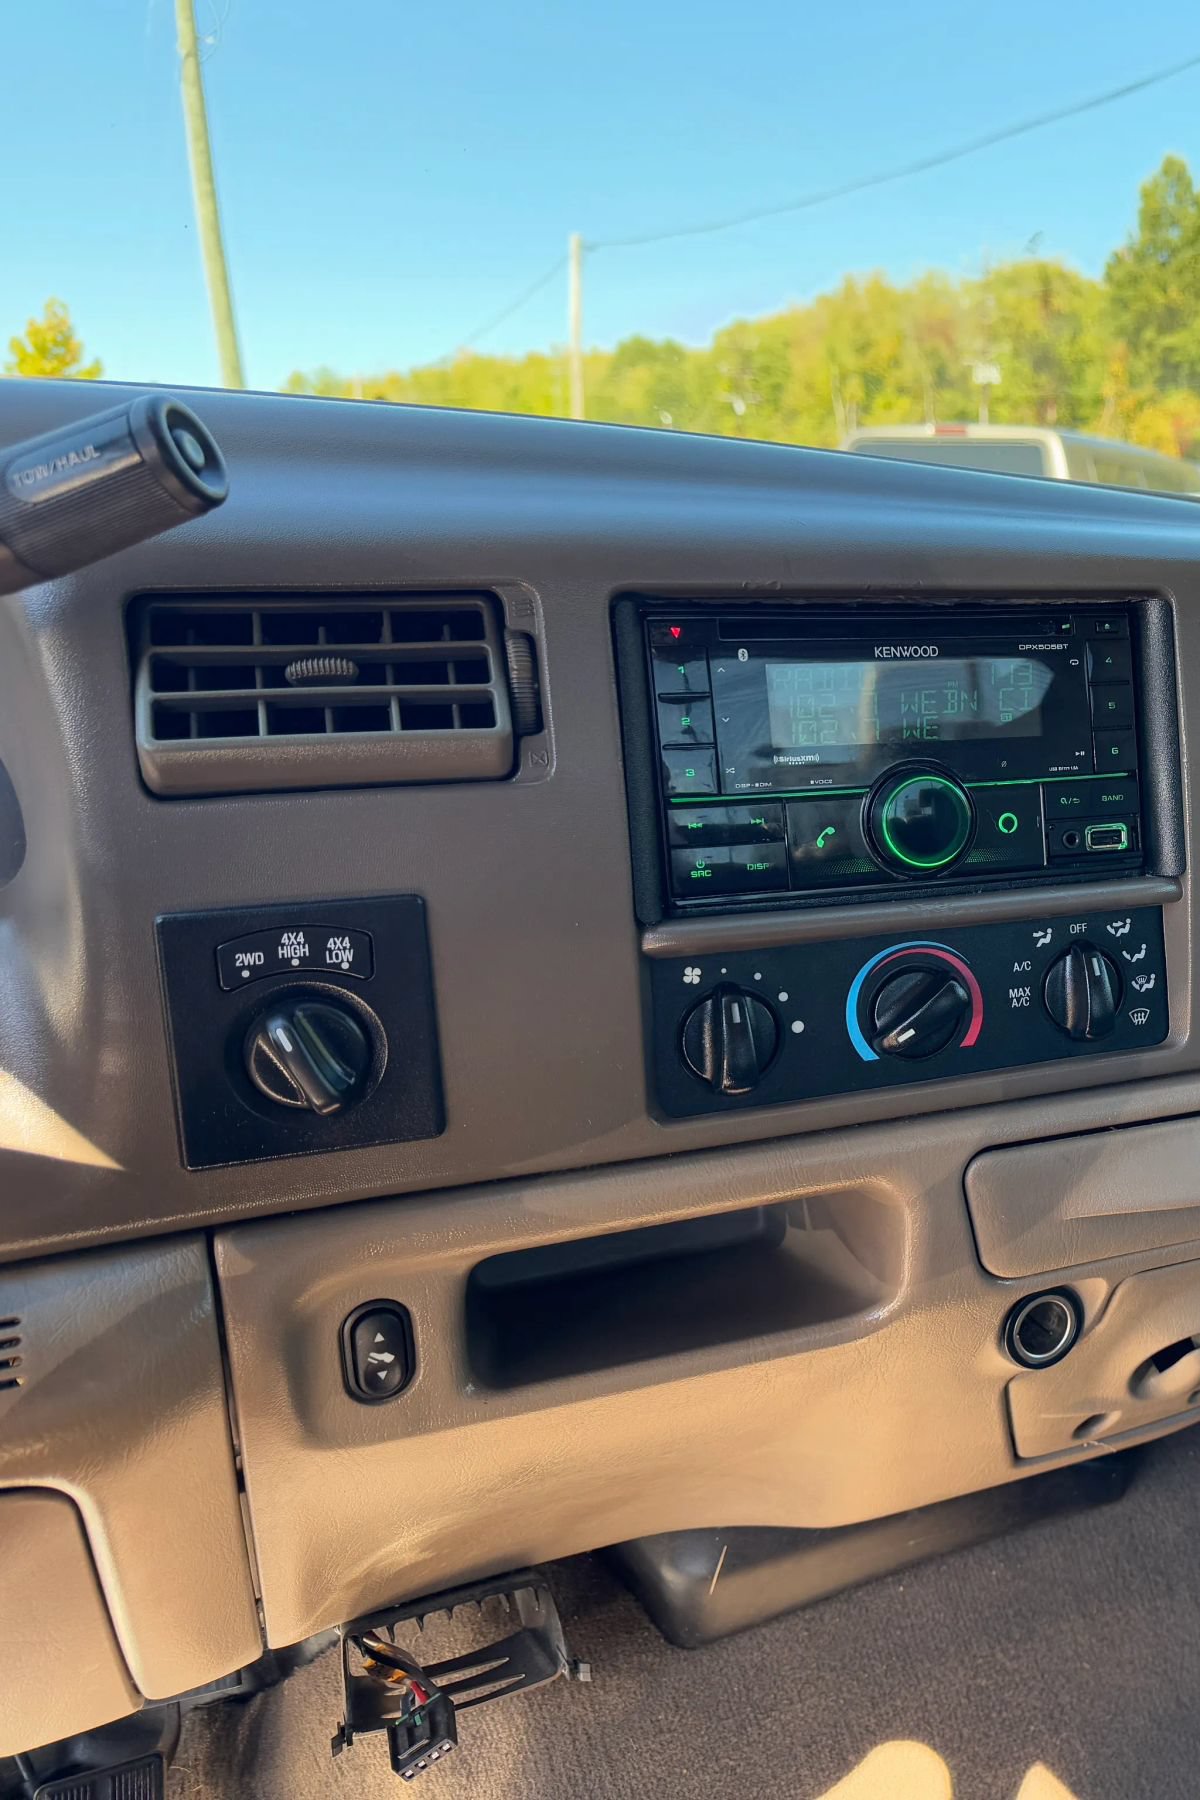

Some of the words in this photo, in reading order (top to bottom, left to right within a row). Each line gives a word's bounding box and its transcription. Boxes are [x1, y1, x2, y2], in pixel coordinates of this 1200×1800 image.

[14, 445, 100, 487] TOW/HAUL
[874, 646, 939, 658] KENWOOD
[1105, 656, 1112, 664] 4
[678, 666, 685, 674] 1
[901, 690, 977, 715] WEBN
[1108, 701, 1116, 709] 5
[681, 717, 691, 726] 2
[903, 715, 939, 740] WE
[685, 768, 695, 777] 3
[1101, 794, 1124, 802] BAND
[747, 862, 770, 871] DISP
[690, 869, 712, 878] SRC
[1070, 922, 1088, 934] OFF
[281, 931, 305, 945] 4X4
[327, 936, 351, 950] 4X4
[278, 944, 309, 959] HIGH
[326, 949, 354, 964] LOW
[235, 952, 265, 967] 2WD
[1013, 960, 1031, 972] A/C
[1009, 986, 1031, 998] MAX
[1011, 997, 1030, 1008] A/C
